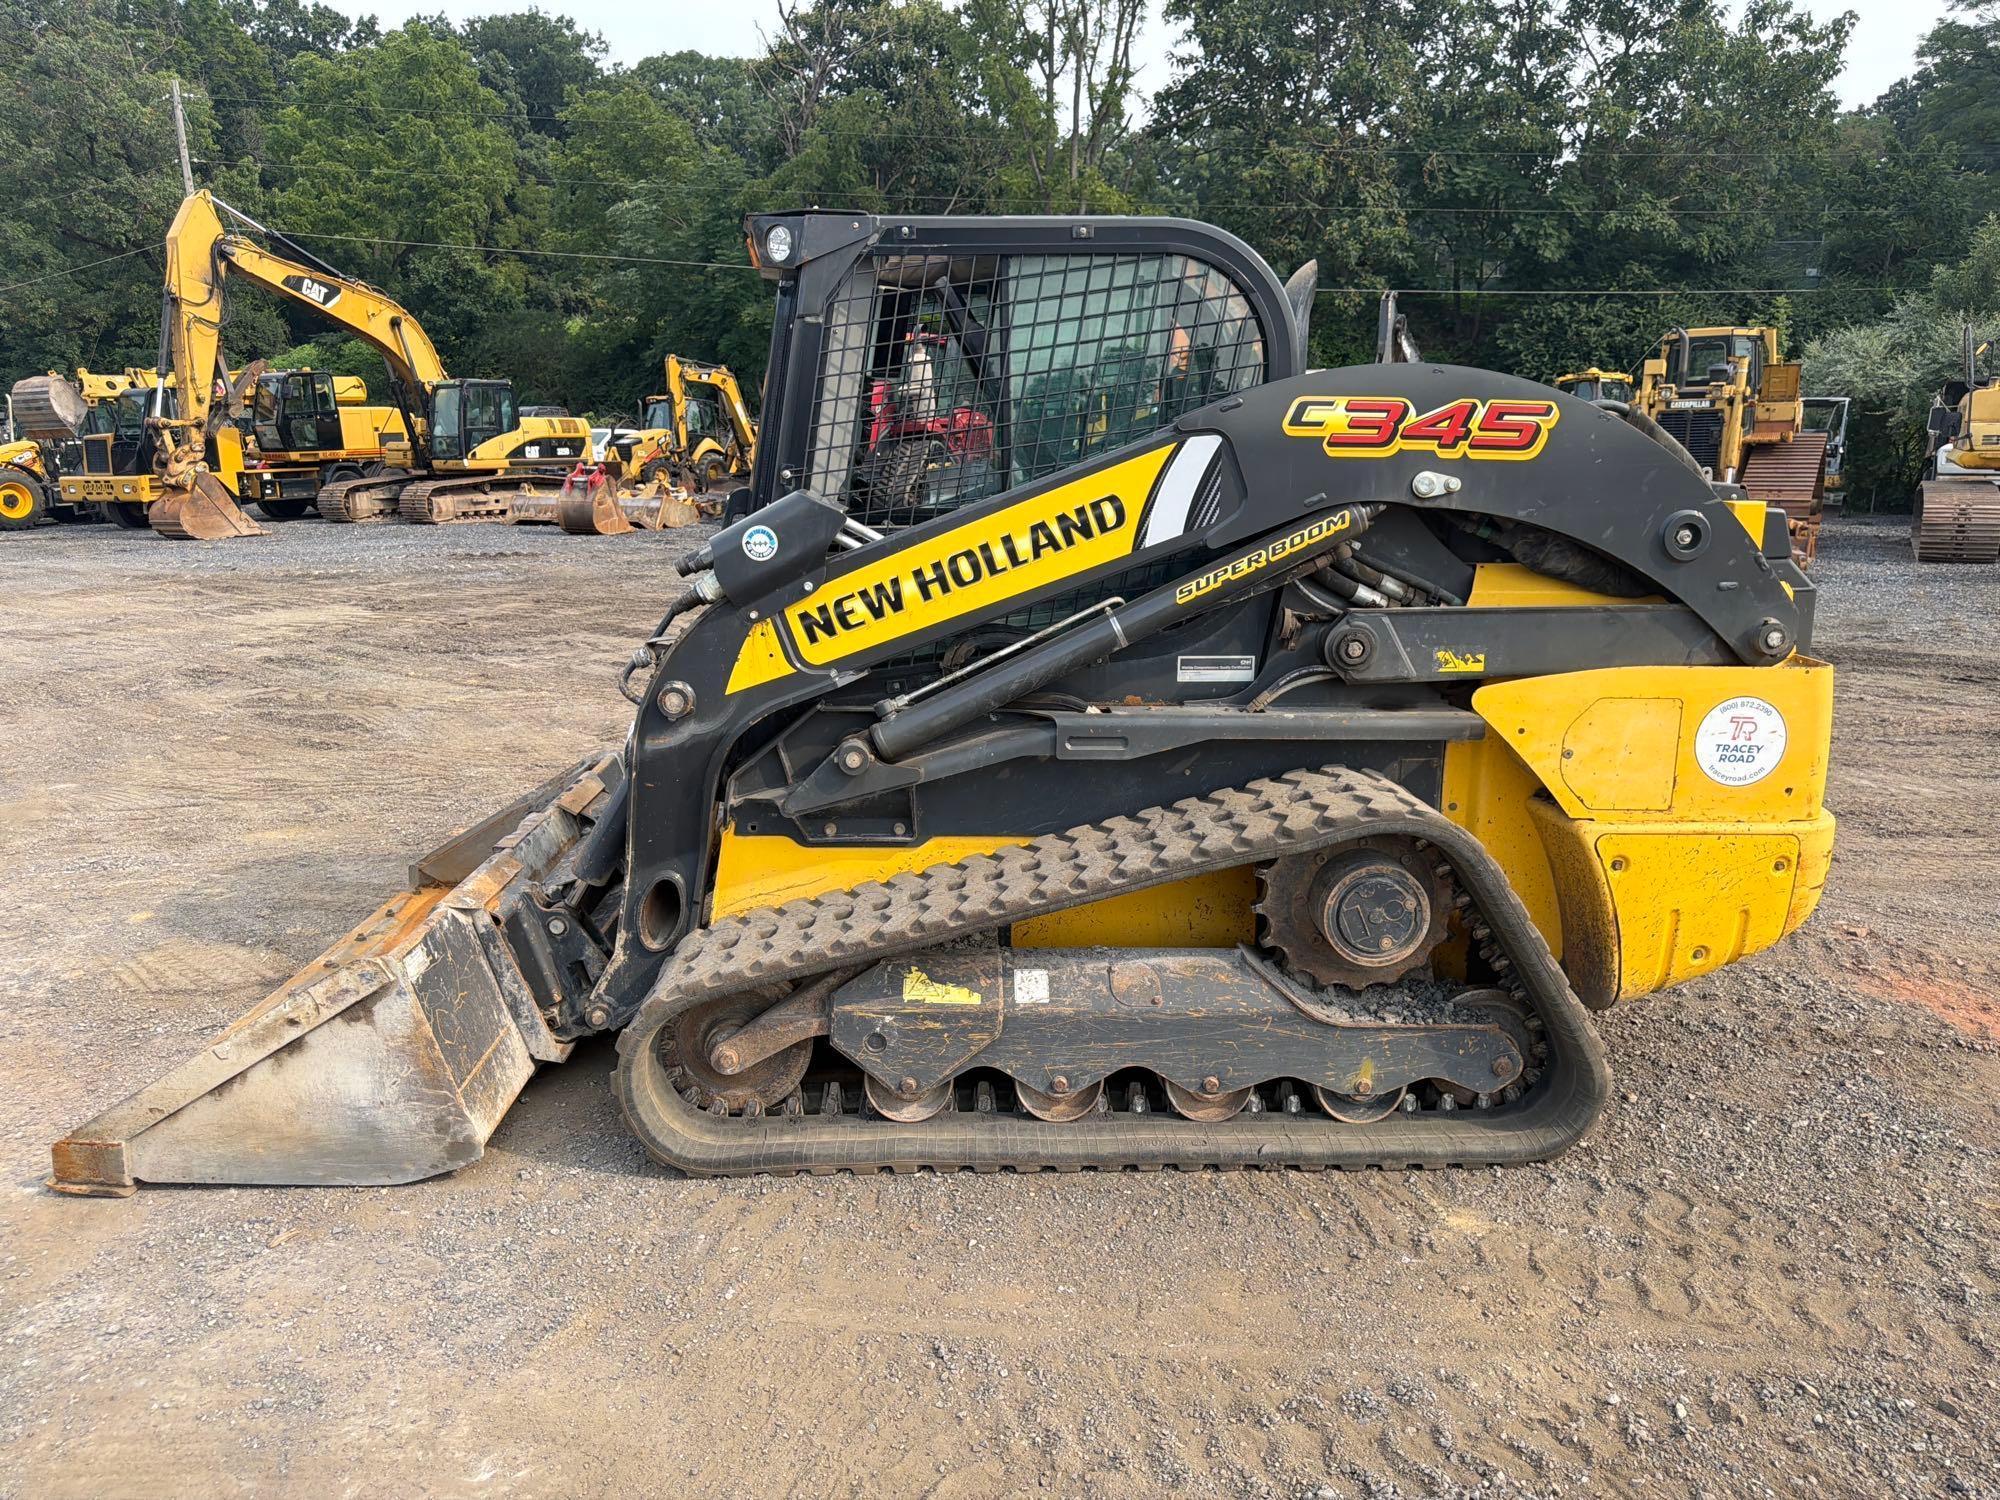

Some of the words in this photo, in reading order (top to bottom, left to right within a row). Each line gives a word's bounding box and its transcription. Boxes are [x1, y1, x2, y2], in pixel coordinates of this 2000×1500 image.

[302, 278, 329, 303] CAT
[1670, 400, 1710, 408] CATERPILLAR
[1282, 396, 1560, 460] C345
[525, 446, 540, 458] CAT
[1176, 550, 1267, 604] SUPER
[1269, 510, 1350, 562] BOOM
[797, 576, 904, 645] NEW
[911, 494, 1127, 602] HOLLAND
[1719, 701, 1738, 714] (800)
[1740, 701, 1773, 717] 872.2390
[1715, 743, 1764, 754] TRACEY
[1718, 754, 1755, 763] ROAD
[1708, 764, 1765, 782] traceyroad.com
